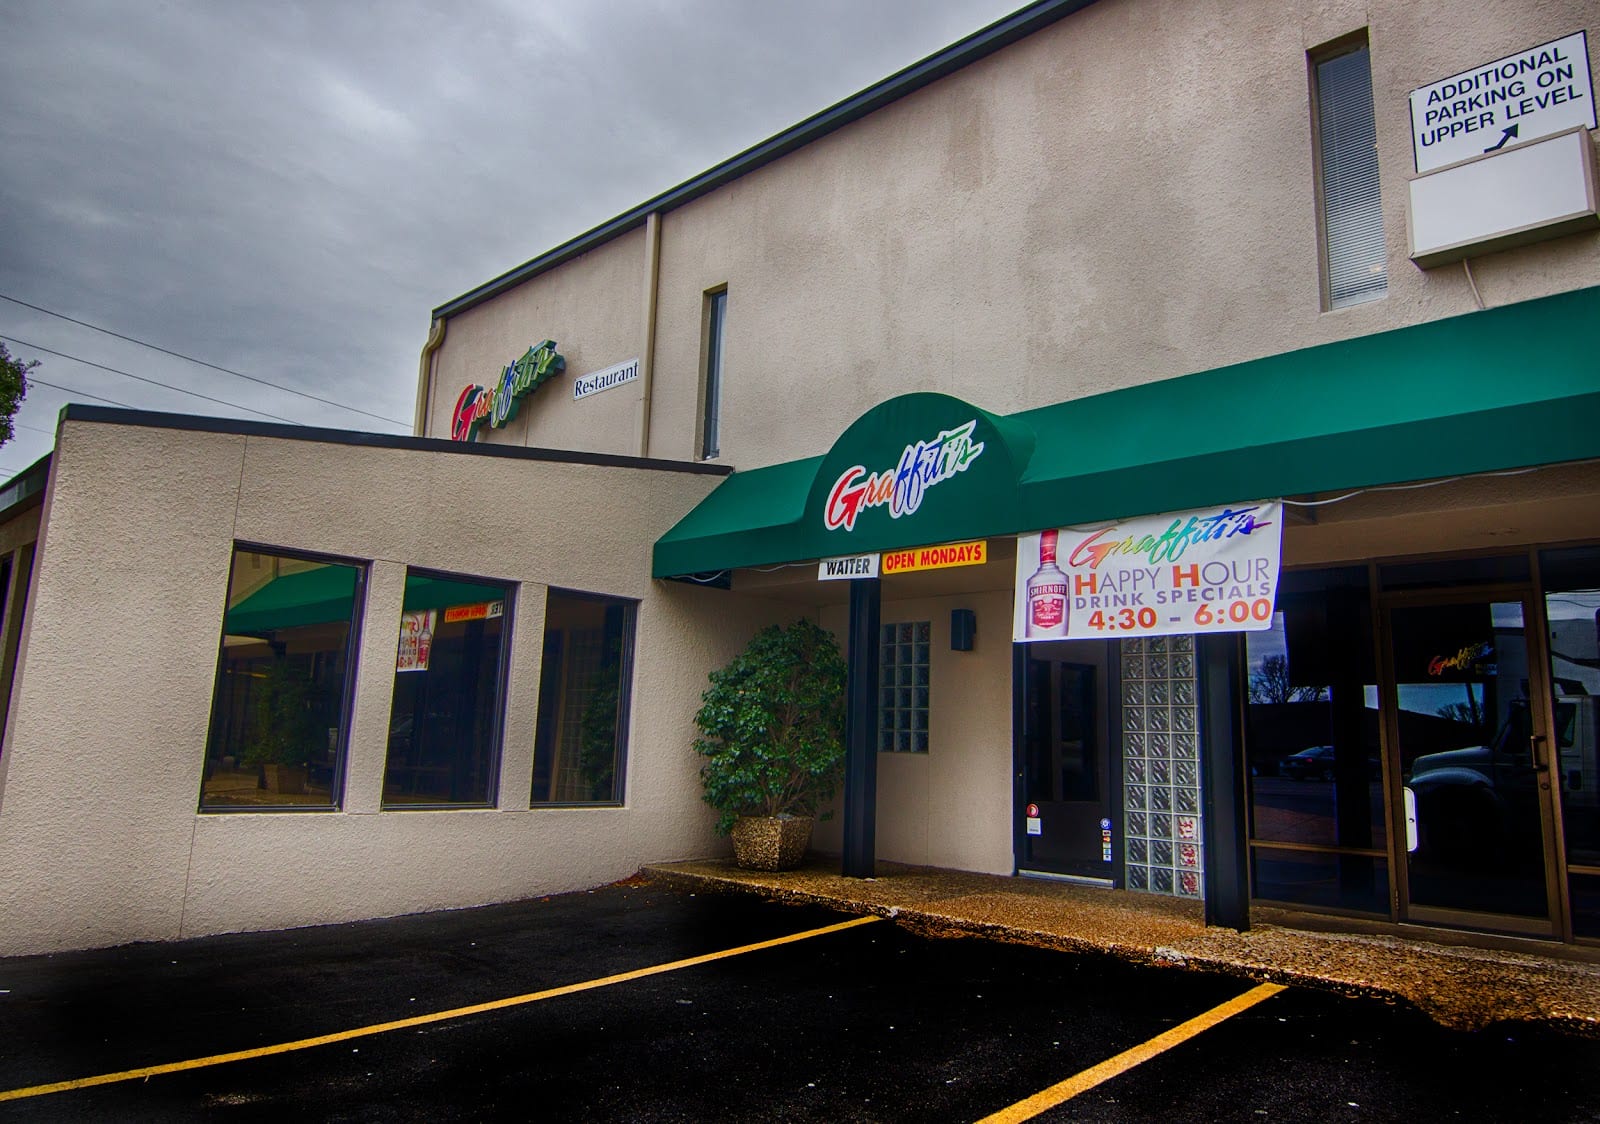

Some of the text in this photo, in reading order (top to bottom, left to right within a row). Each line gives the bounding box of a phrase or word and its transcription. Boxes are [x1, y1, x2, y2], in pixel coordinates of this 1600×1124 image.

[1425, 63, 1573, 126] PARKING ON
[1427, 47, 1568, 106] ADDITIONAL
[1421, 84, 1583, 147] UPPER LEVEL
[575, 361, 638, 396] Restaurant
[826, 422, 981, 529] Graffiti's
[1069, 506, 1272, 569] Graffiti's
[826, 557, 870, 576] WAITER
[886, 544, 982, 570] OPEN MONDAYS
[1030, 584, 1066, 597] SMIRNOFF
[1074, 557, 1270, 595] HAPPY HOUR
[1075, 581, 1271, 610] DRINK SPECIALS
[1088, 607, 1157, 630] 4:30
[1194, 598, 1271, 627] 6:00
